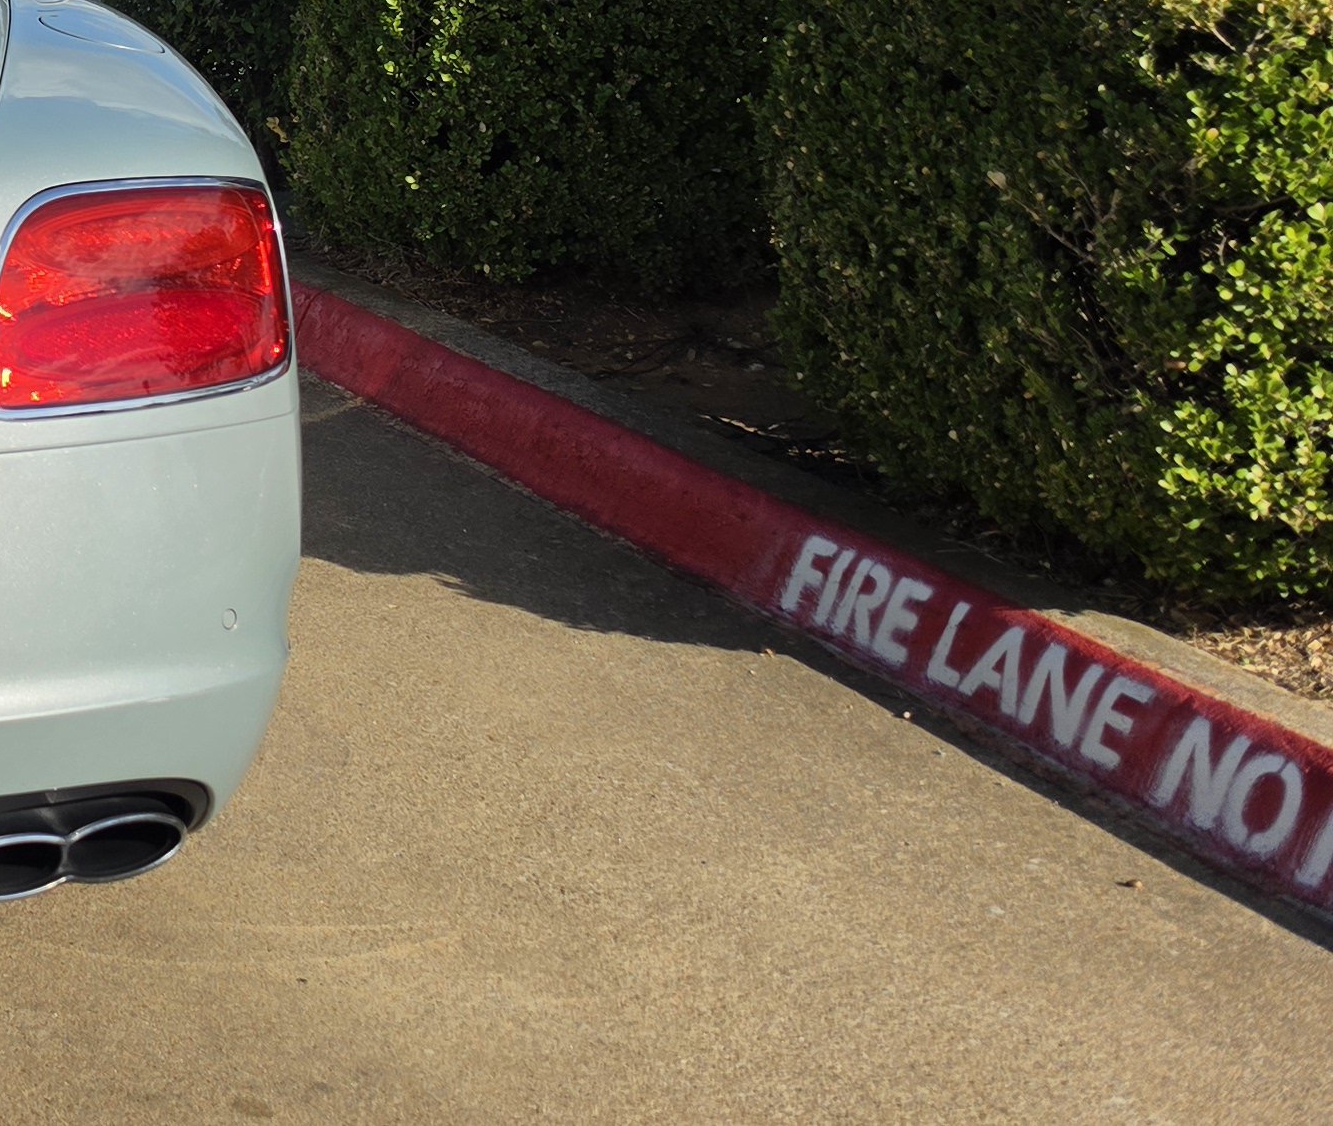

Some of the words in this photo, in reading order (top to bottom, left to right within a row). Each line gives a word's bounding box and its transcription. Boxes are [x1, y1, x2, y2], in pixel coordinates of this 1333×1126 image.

[780, 534, 933, 667] FIRE
[927, 600, 1155, 771] LANE
[1150, 716, 1304, 861] NO
